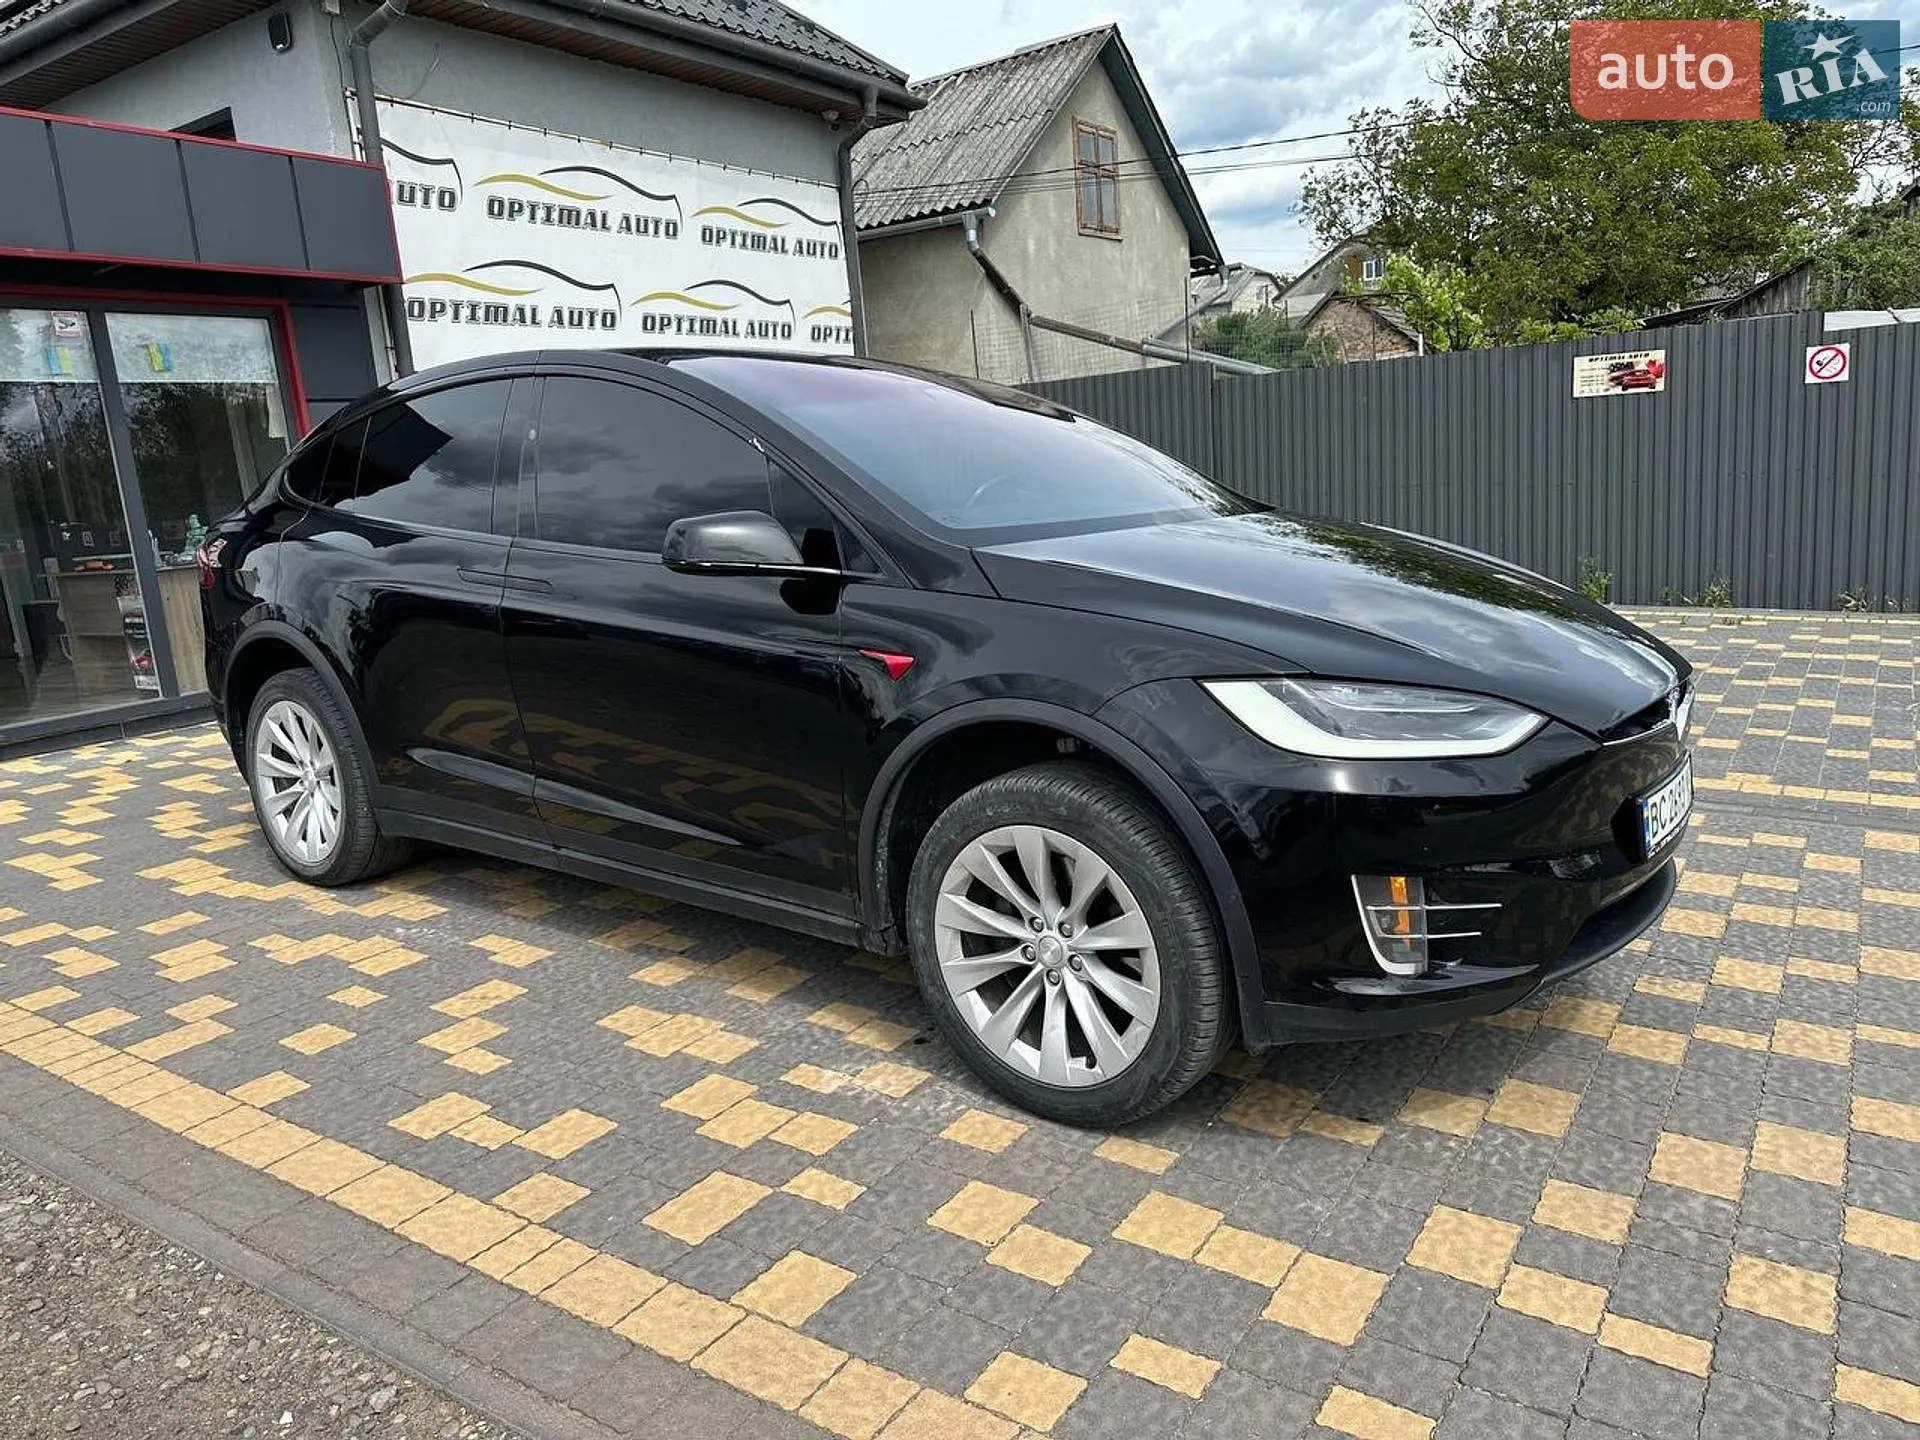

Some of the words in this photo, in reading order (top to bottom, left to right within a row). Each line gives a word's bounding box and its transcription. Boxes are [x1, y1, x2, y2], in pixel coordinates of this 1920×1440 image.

[391, 180, 457, 212] UTO
[486, 194, 612, 232] OPTIMAL
[616, 213, 680, 240] AUTO
[700, 224, 788, 254] OPTIMAL
[792, 237, 839, 260] AUTO
[406, 296, 542, 328] OPTIMAL
[547, 304, 618, 331] AUTO
[641, 311, 740, 339] OPTIMAL
[744, 319, 793, 341] AUTO
[810, 323, 852, 345] OPTI
